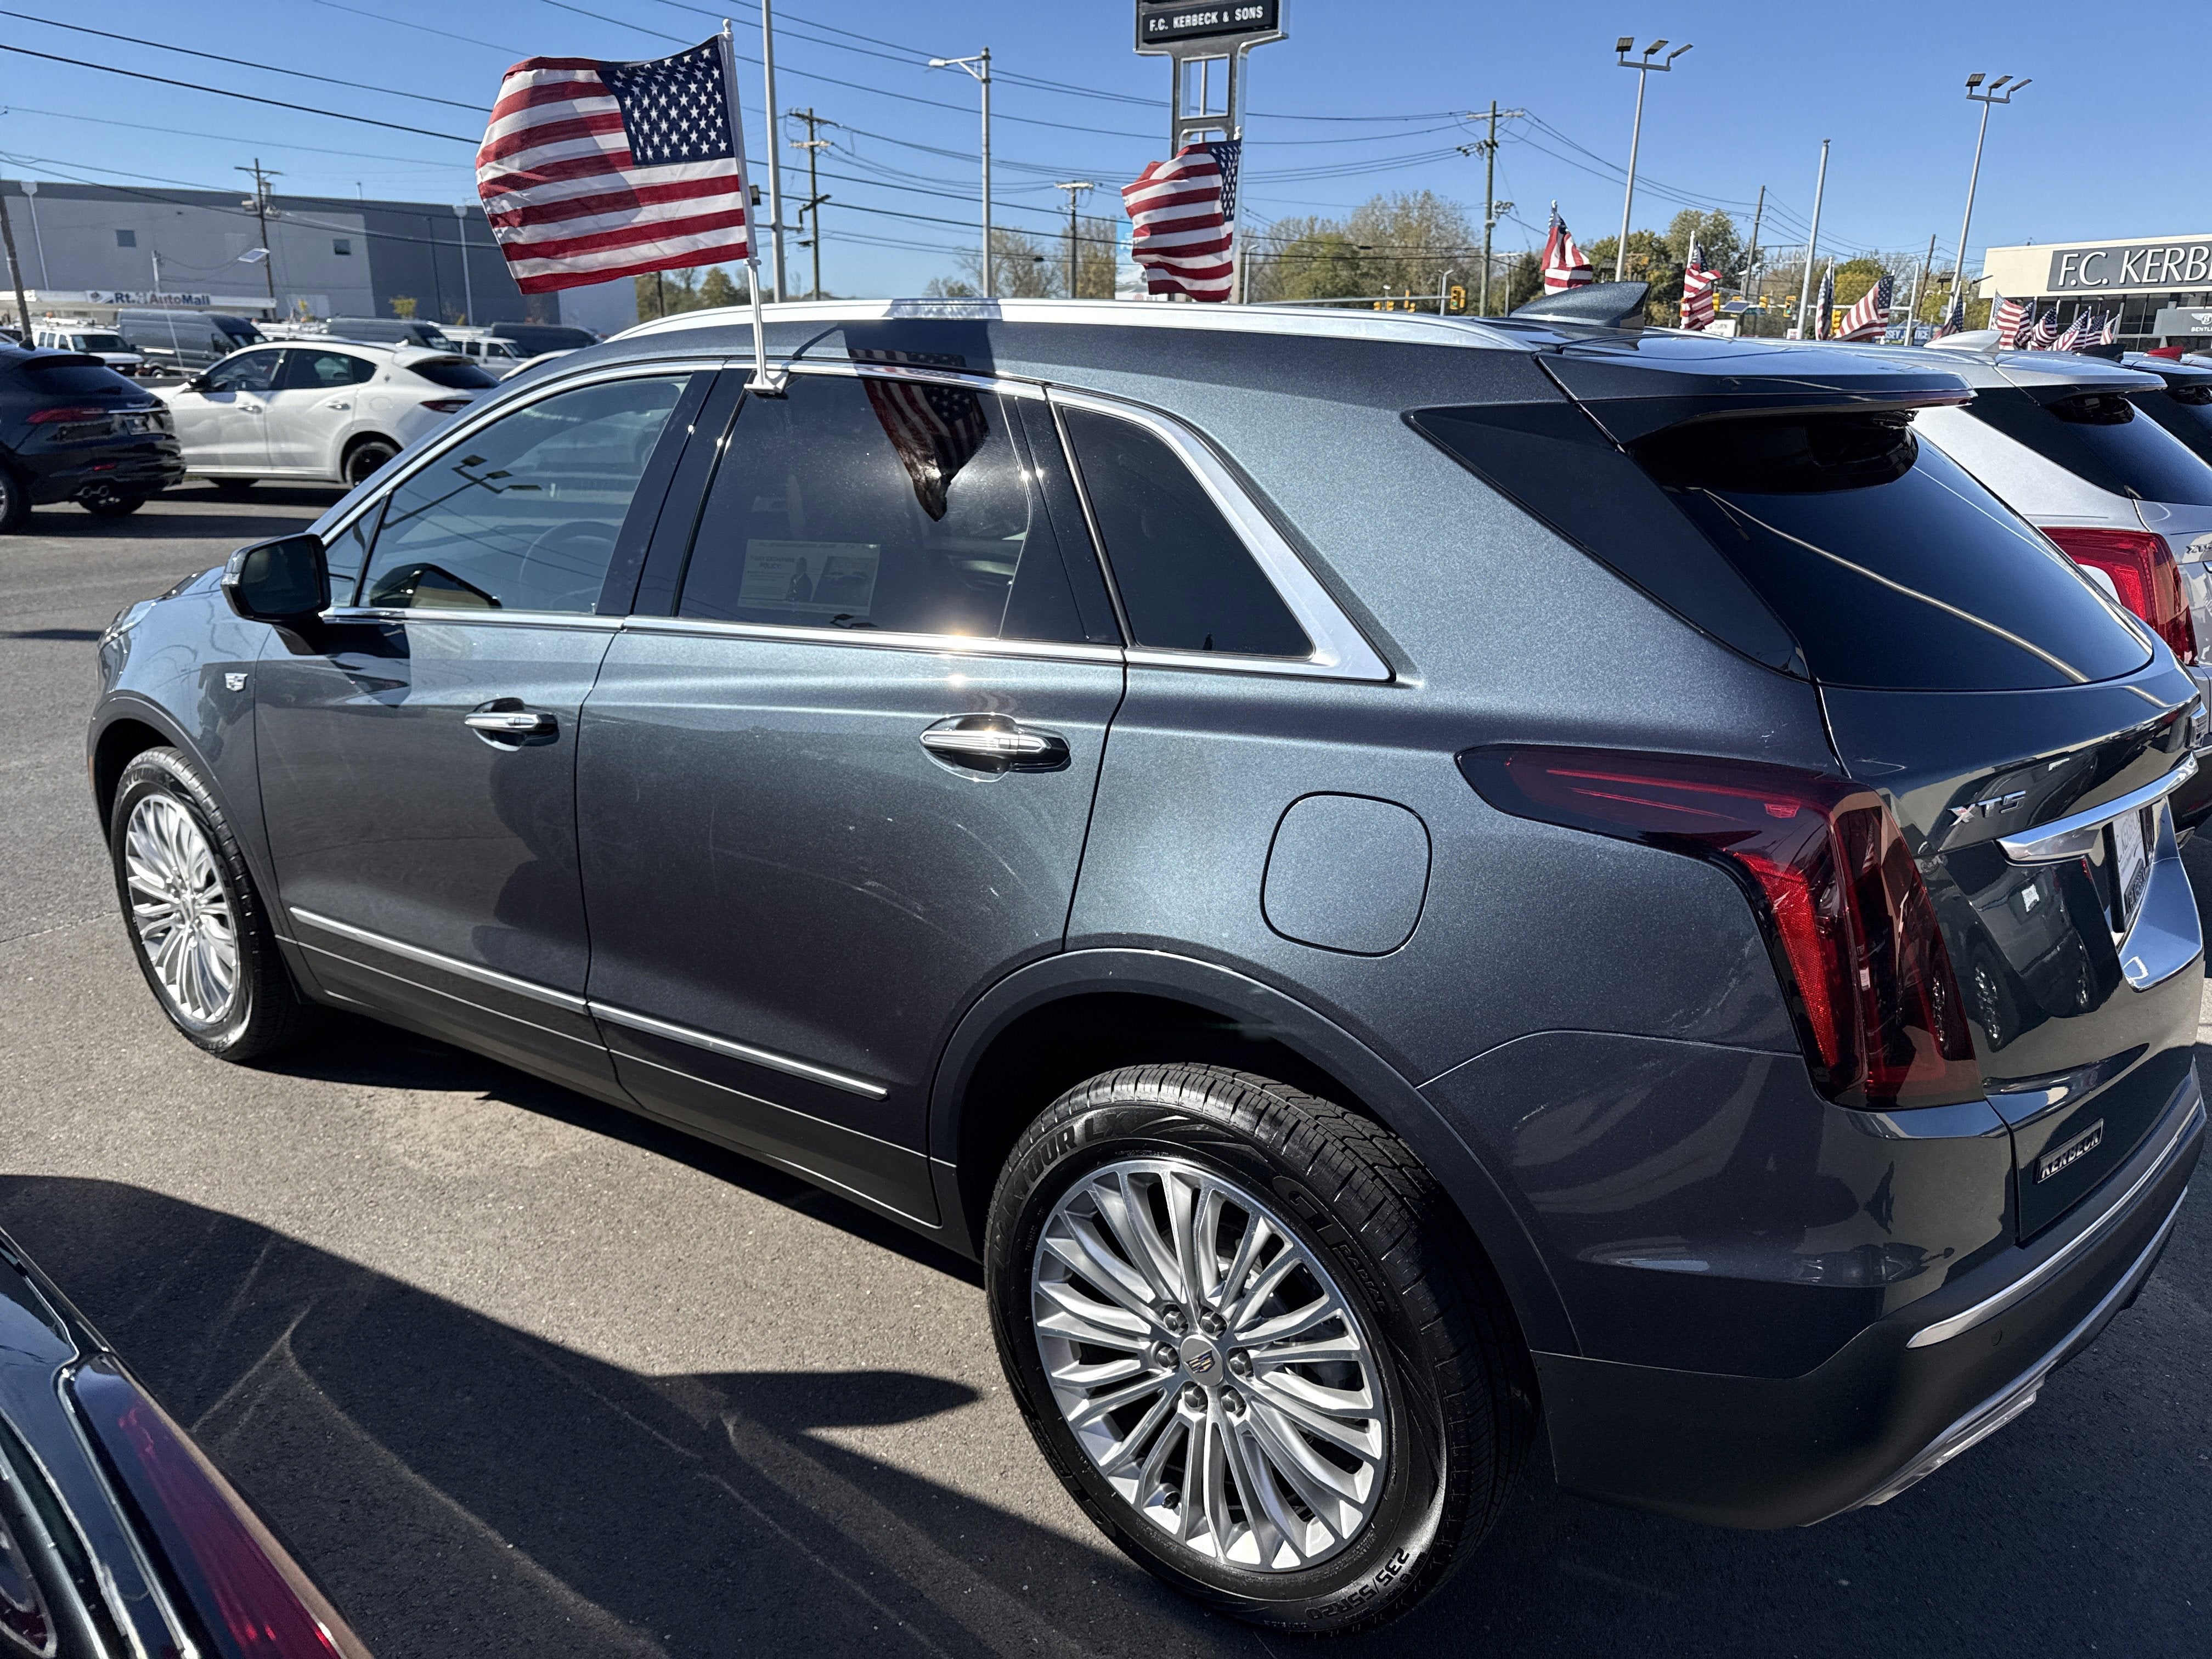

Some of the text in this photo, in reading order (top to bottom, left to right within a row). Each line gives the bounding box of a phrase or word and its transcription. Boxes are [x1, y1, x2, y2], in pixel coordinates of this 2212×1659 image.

[1149, 5, 1263, 32] F.C. KERBECK & SONS
[2058, 251, 2109, 287] F.C.
[1947, 791, 2026, 826] XT5
[1306, 1547, 1410, 1620] 235/55R20
